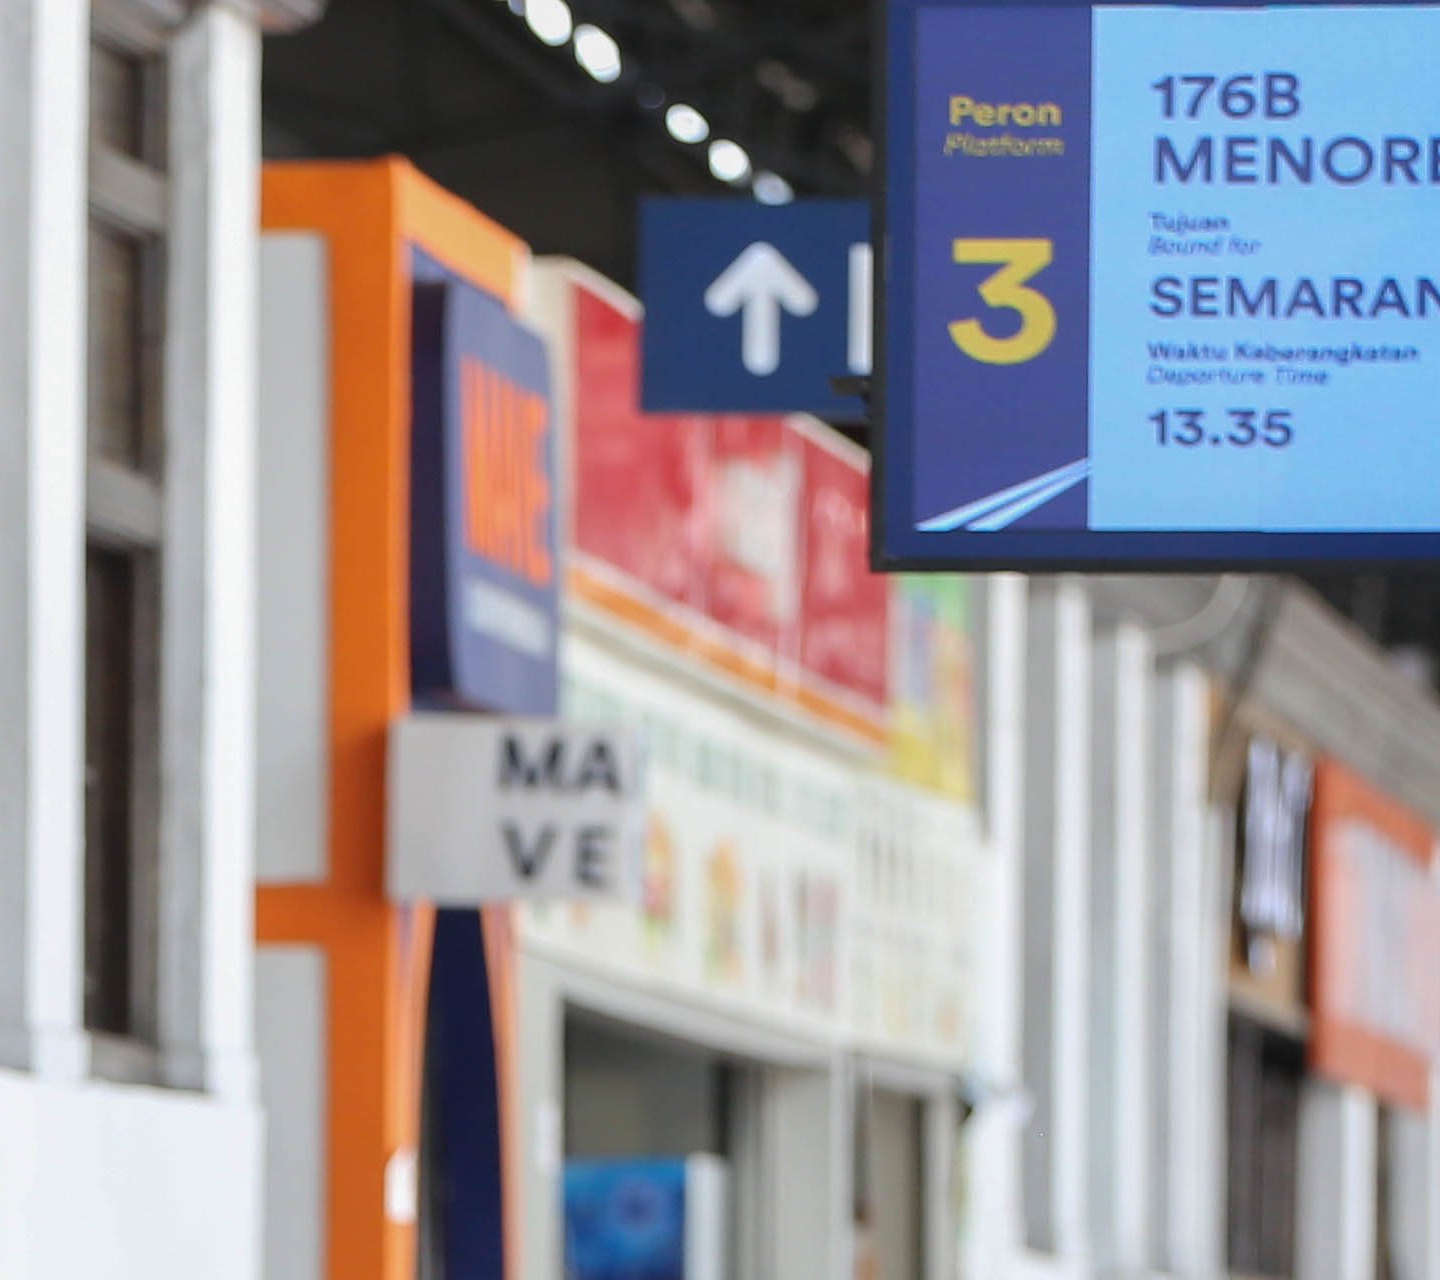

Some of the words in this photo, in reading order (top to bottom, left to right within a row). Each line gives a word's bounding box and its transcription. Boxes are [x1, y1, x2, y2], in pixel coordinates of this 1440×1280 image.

[949, 95, 1063, 126] Peron
[1151, 72, 1301, 120] 176B
[944, 132, 1065, 157] Platform
[1148, 212, 1230, 235] Tujuan
[1148, 235, 1222, 256] Bound
[947, 237, 1057, 365] 3
[1147, 341, 1227, 362] Waktu
[1147, 365, 1266, 385] Departure
[1148, 408, 1293, 447] 13.35
[498, 735, 620, 793] MA
[501, 823, 615, 888] VE
